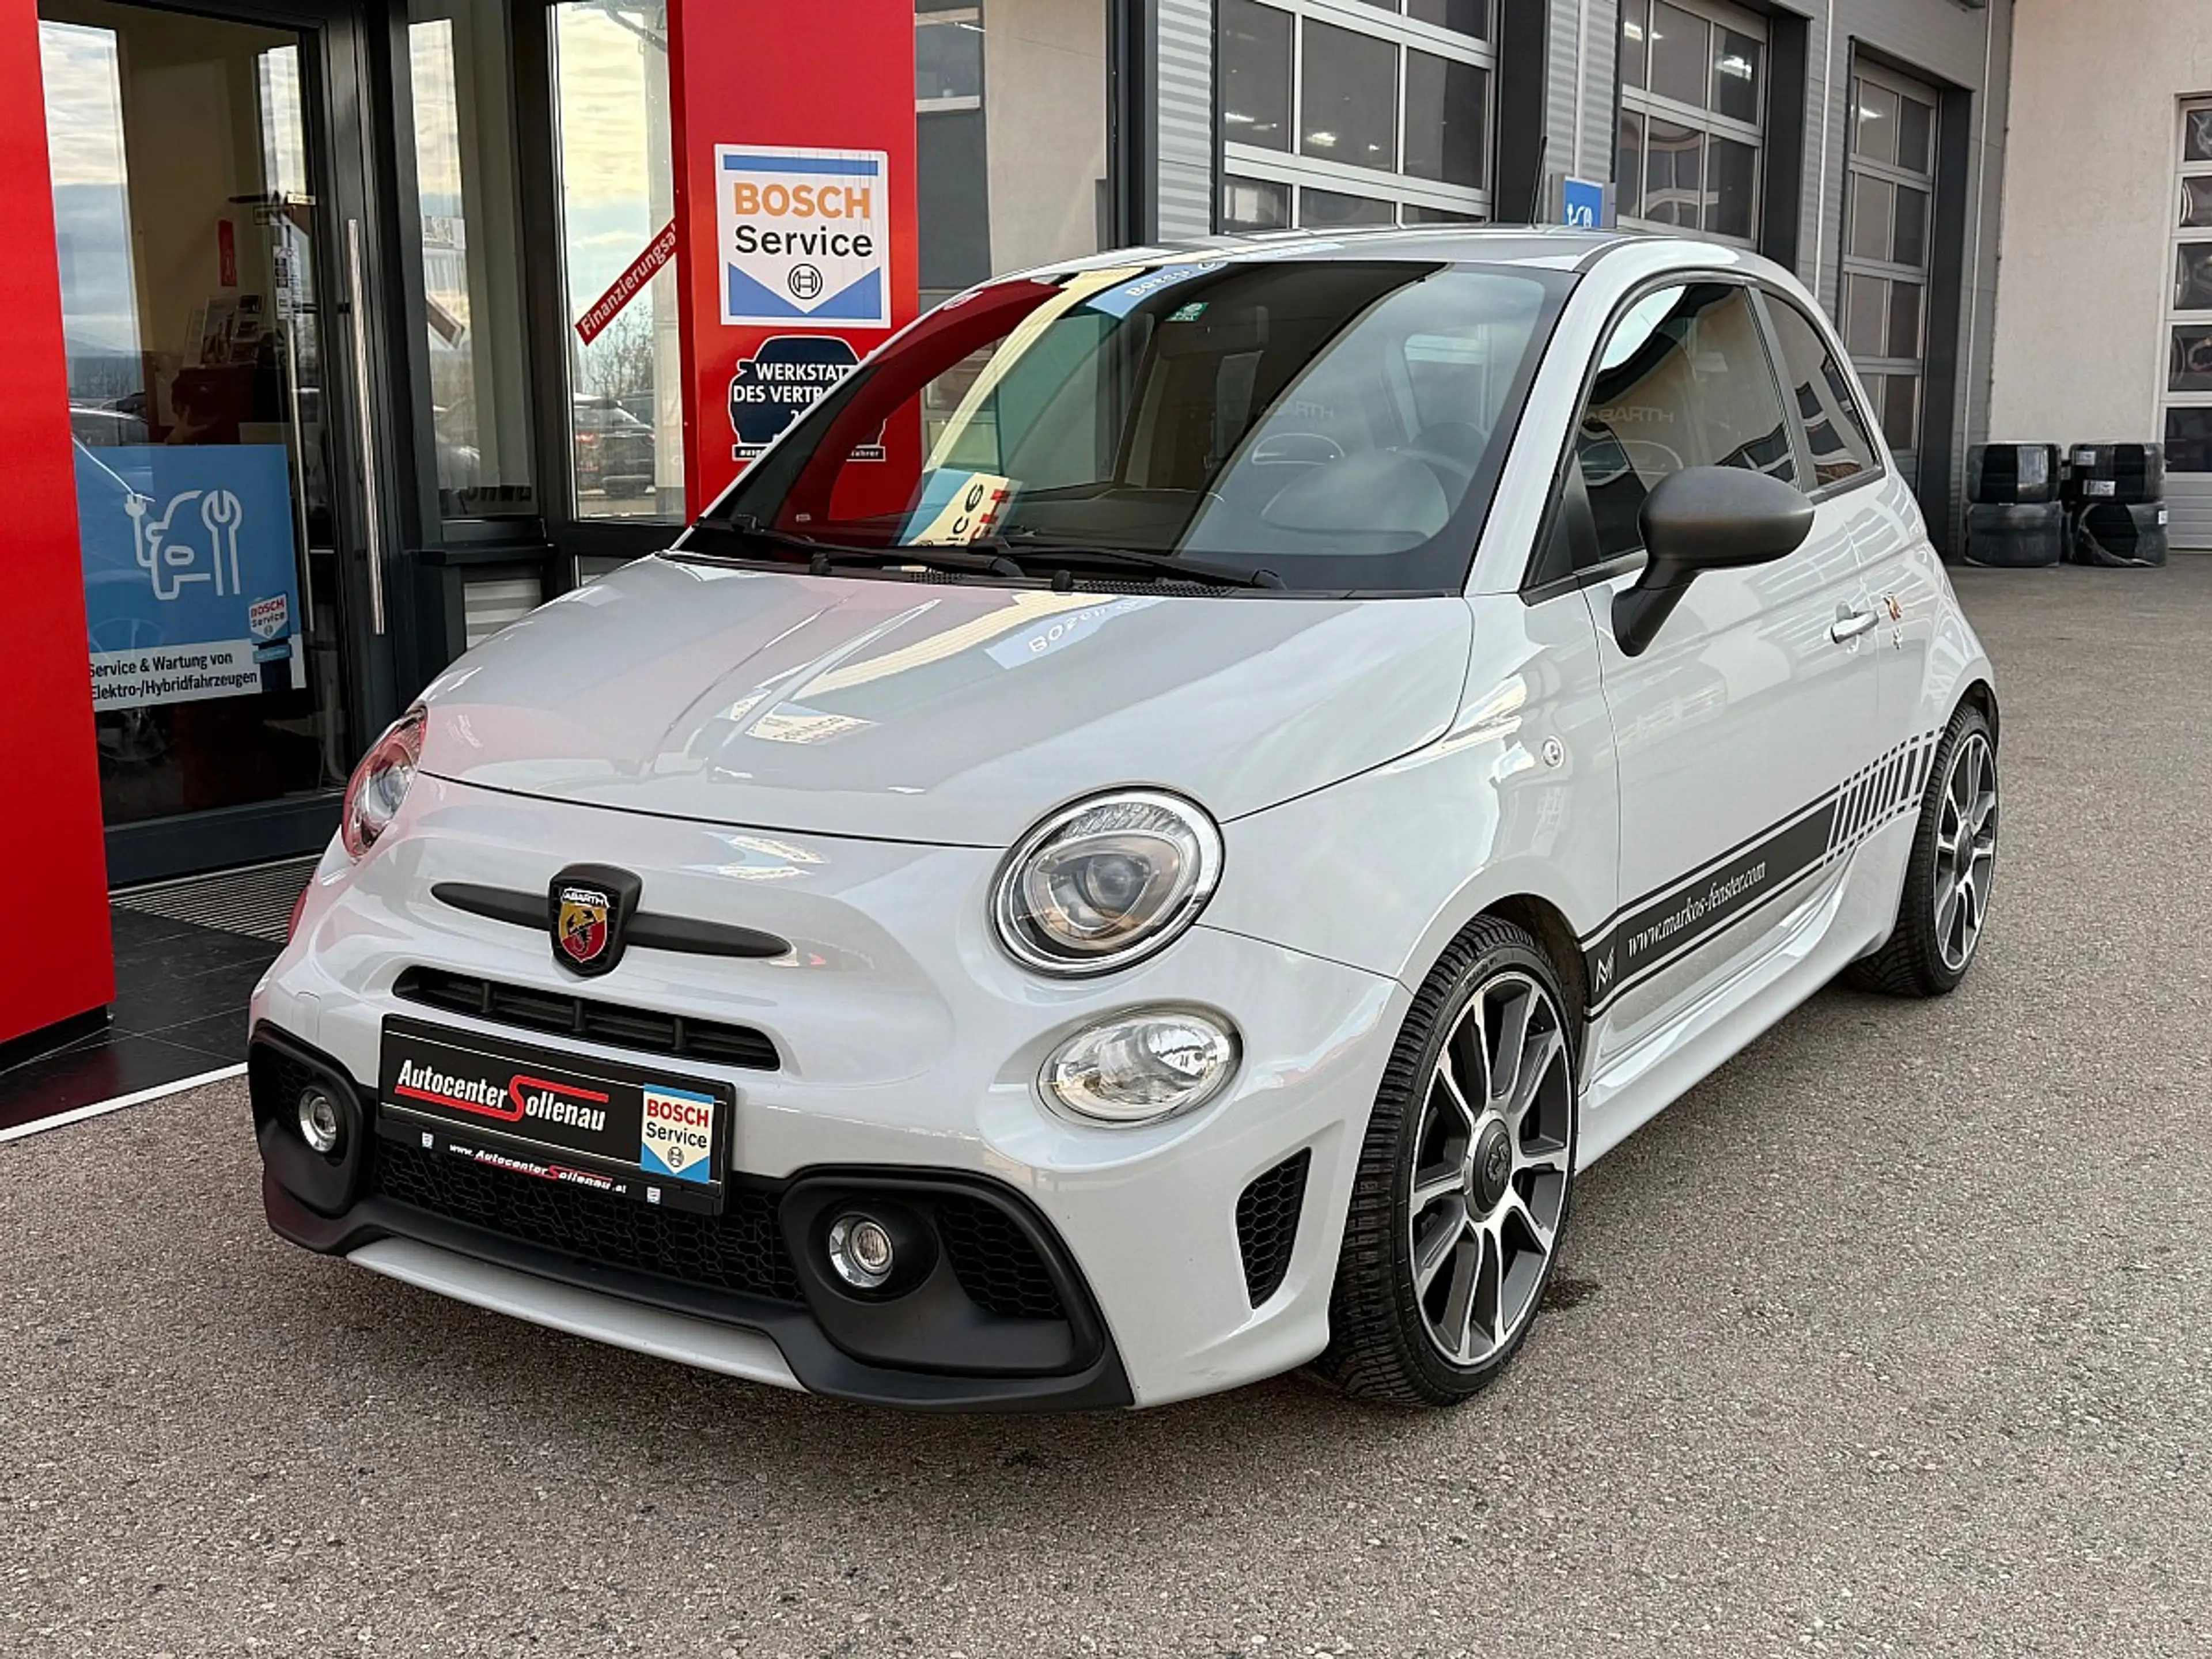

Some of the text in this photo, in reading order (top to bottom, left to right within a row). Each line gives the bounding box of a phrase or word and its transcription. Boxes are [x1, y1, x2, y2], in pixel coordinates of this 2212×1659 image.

[734, 183, 870, 218] BOSCH
[735, 224, 873, 257] Service
[733, 386, 835, 403] DES VERTR
[139, 658, 150, 672] &
[152, 655, 208, 670] Wartung
[209, 652, 233, 665] von
[563, 892, 604, 906] ABARTH
[1627, 861, 1766, 958] www.markos-fenster.com
[647, 1099, 709, 1128] BOSCH
[645, 1121, 707, 1149] Service
